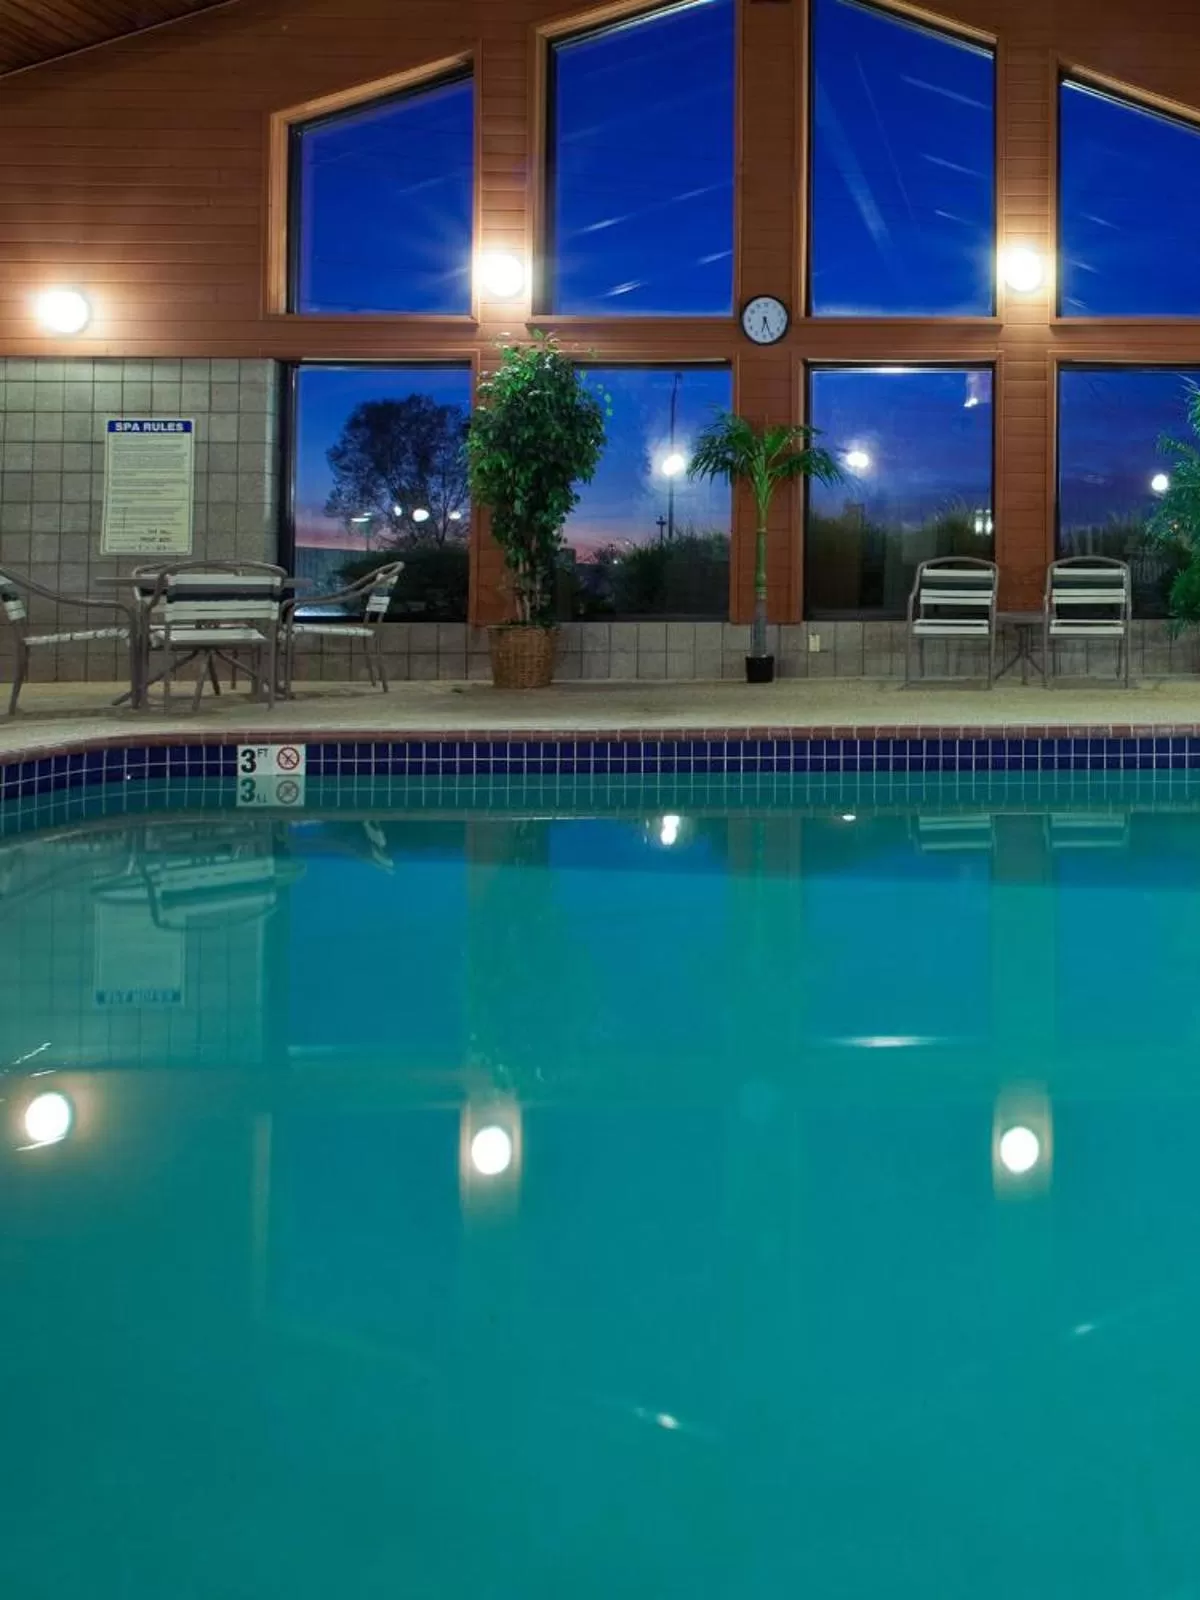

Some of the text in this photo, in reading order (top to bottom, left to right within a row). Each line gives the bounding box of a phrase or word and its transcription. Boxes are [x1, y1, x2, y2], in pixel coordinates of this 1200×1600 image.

[115, 422, 184, 431] SPA RULES
[240, 748, 268, 773] 3 FT
